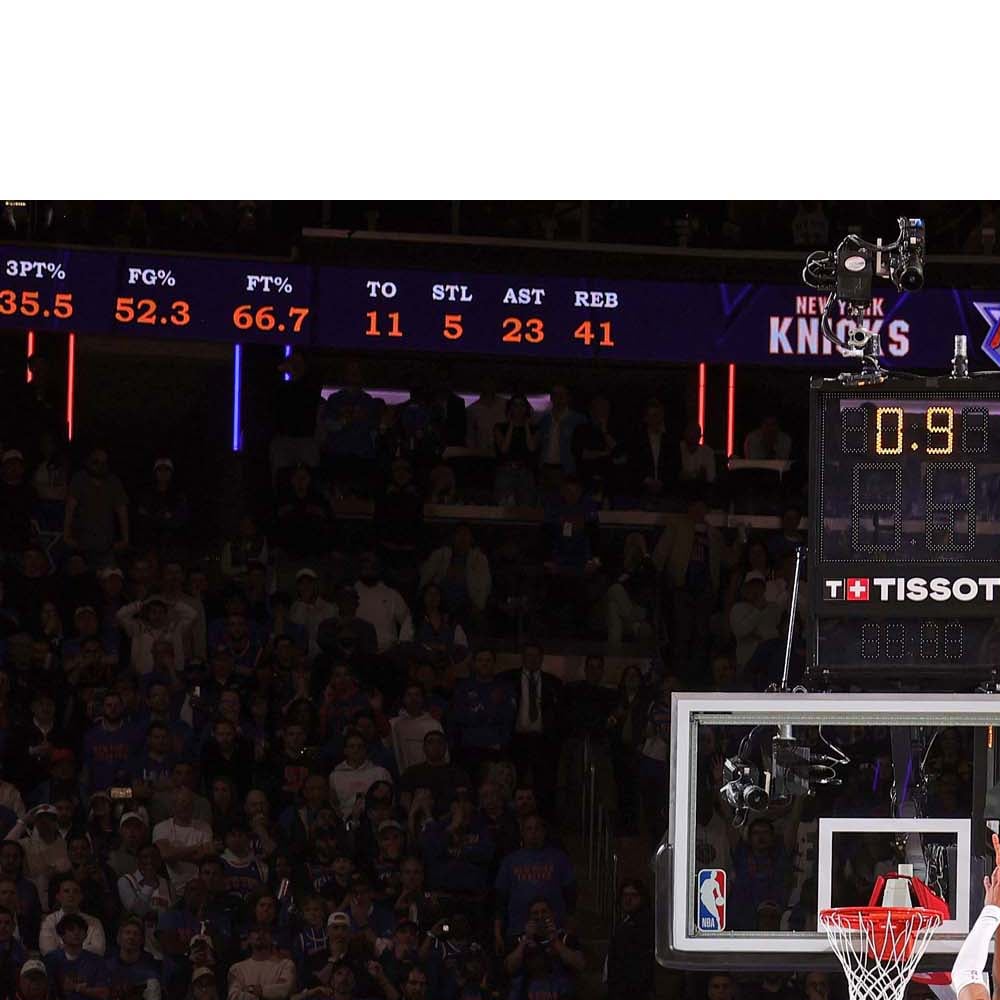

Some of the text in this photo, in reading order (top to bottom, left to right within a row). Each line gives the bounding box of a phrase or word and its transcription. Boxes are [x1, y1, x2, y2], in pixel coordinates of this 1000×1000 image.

[6, 259, 66, 281] 3PT%
[128, 267, 176, 287] FG%
[246, 275, 293, 294] FT%
[366, 280, 397, 298] TO
[432, 284, 473, 302] STL
[502, 287, 546, 305] AST
[0, 289, 73, 318] 35.5
[574, 290, 619, 308] REB
[115, 297, 191, 326] 52.3
[233, 305, 309, 332] 66.7
[366, 311, 403, 337] 11
[443, 314, 463, 340] 5
[502, 317, 545, 343] 23
[574, 321, 614, 346] 41
[875, 406, 955, 455] 0.9
[873, 577, 1000, 601] TISSOT
